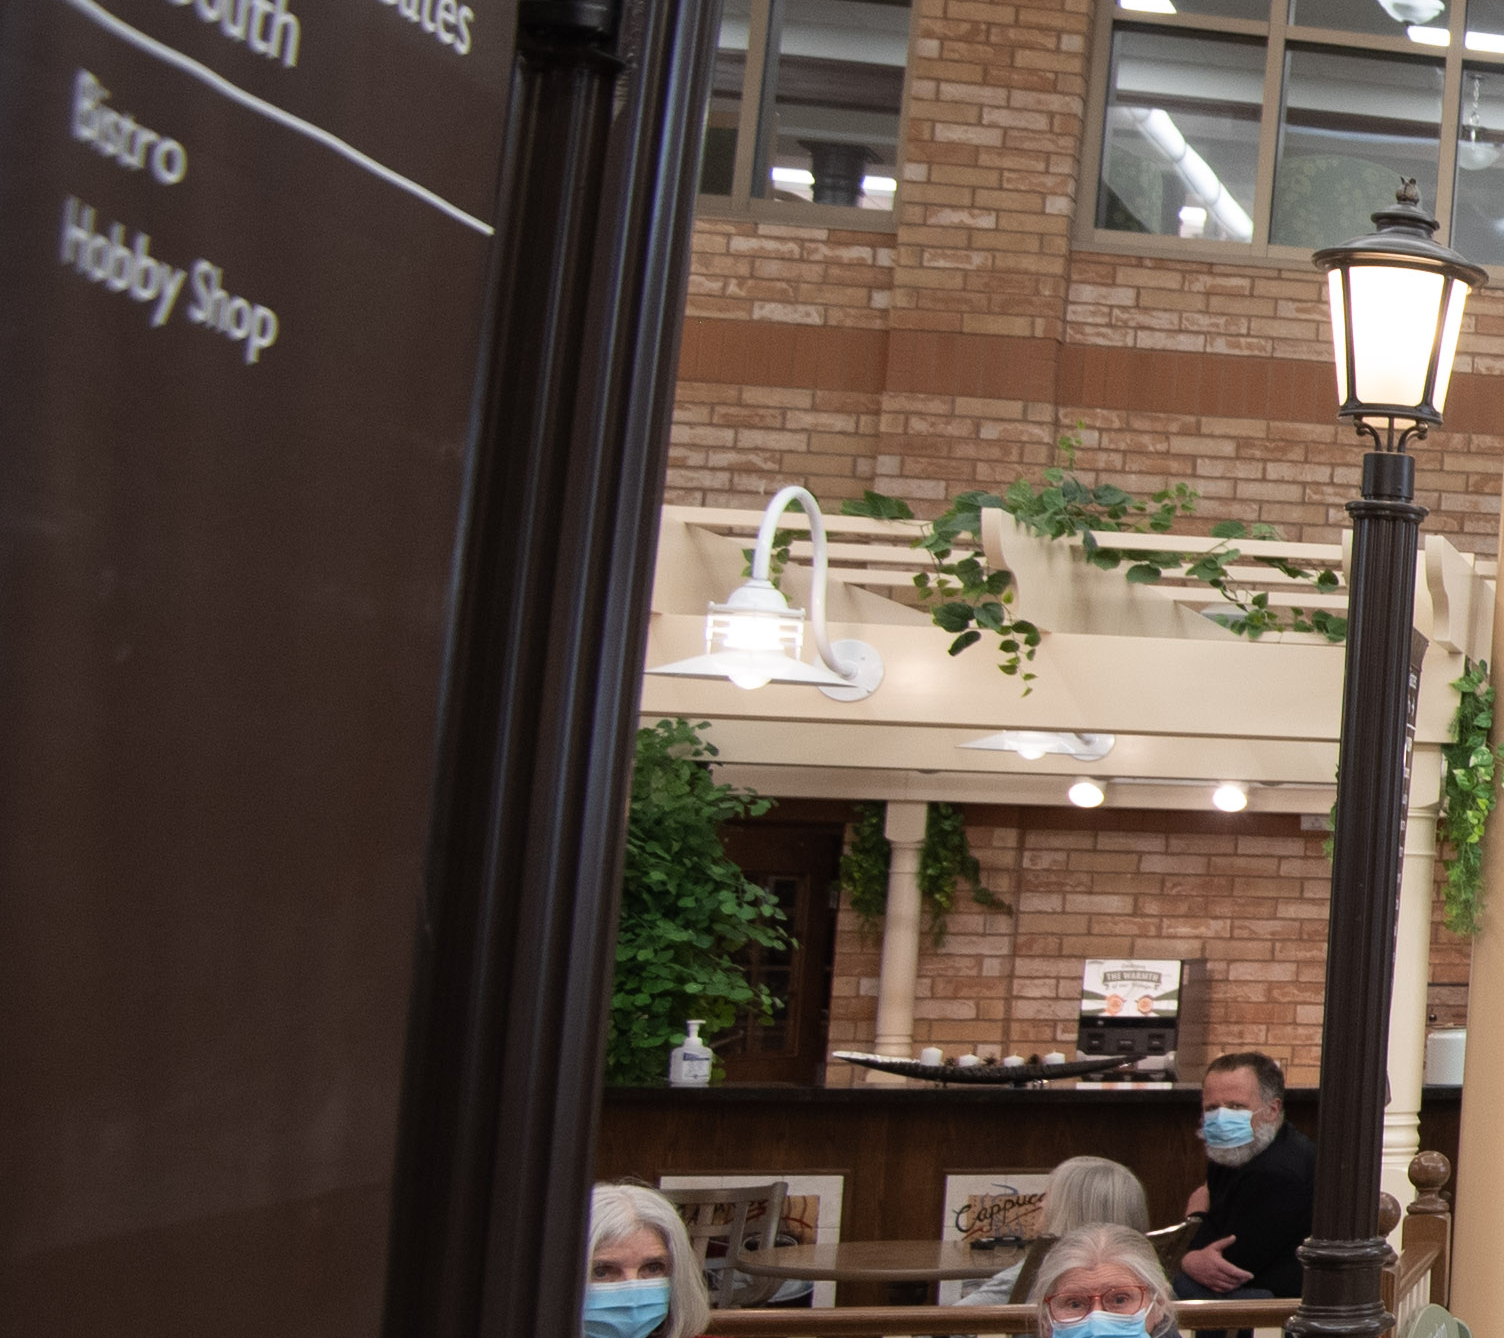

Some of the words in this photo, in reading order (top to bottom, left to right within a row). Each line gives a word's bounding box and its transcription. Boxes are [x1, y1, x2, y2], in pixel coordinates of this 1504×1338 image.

[70, 68, 188, 186] Bistro
[60, 194, 187, 328] Hobby
[189, 258, 279, 363] Shop
